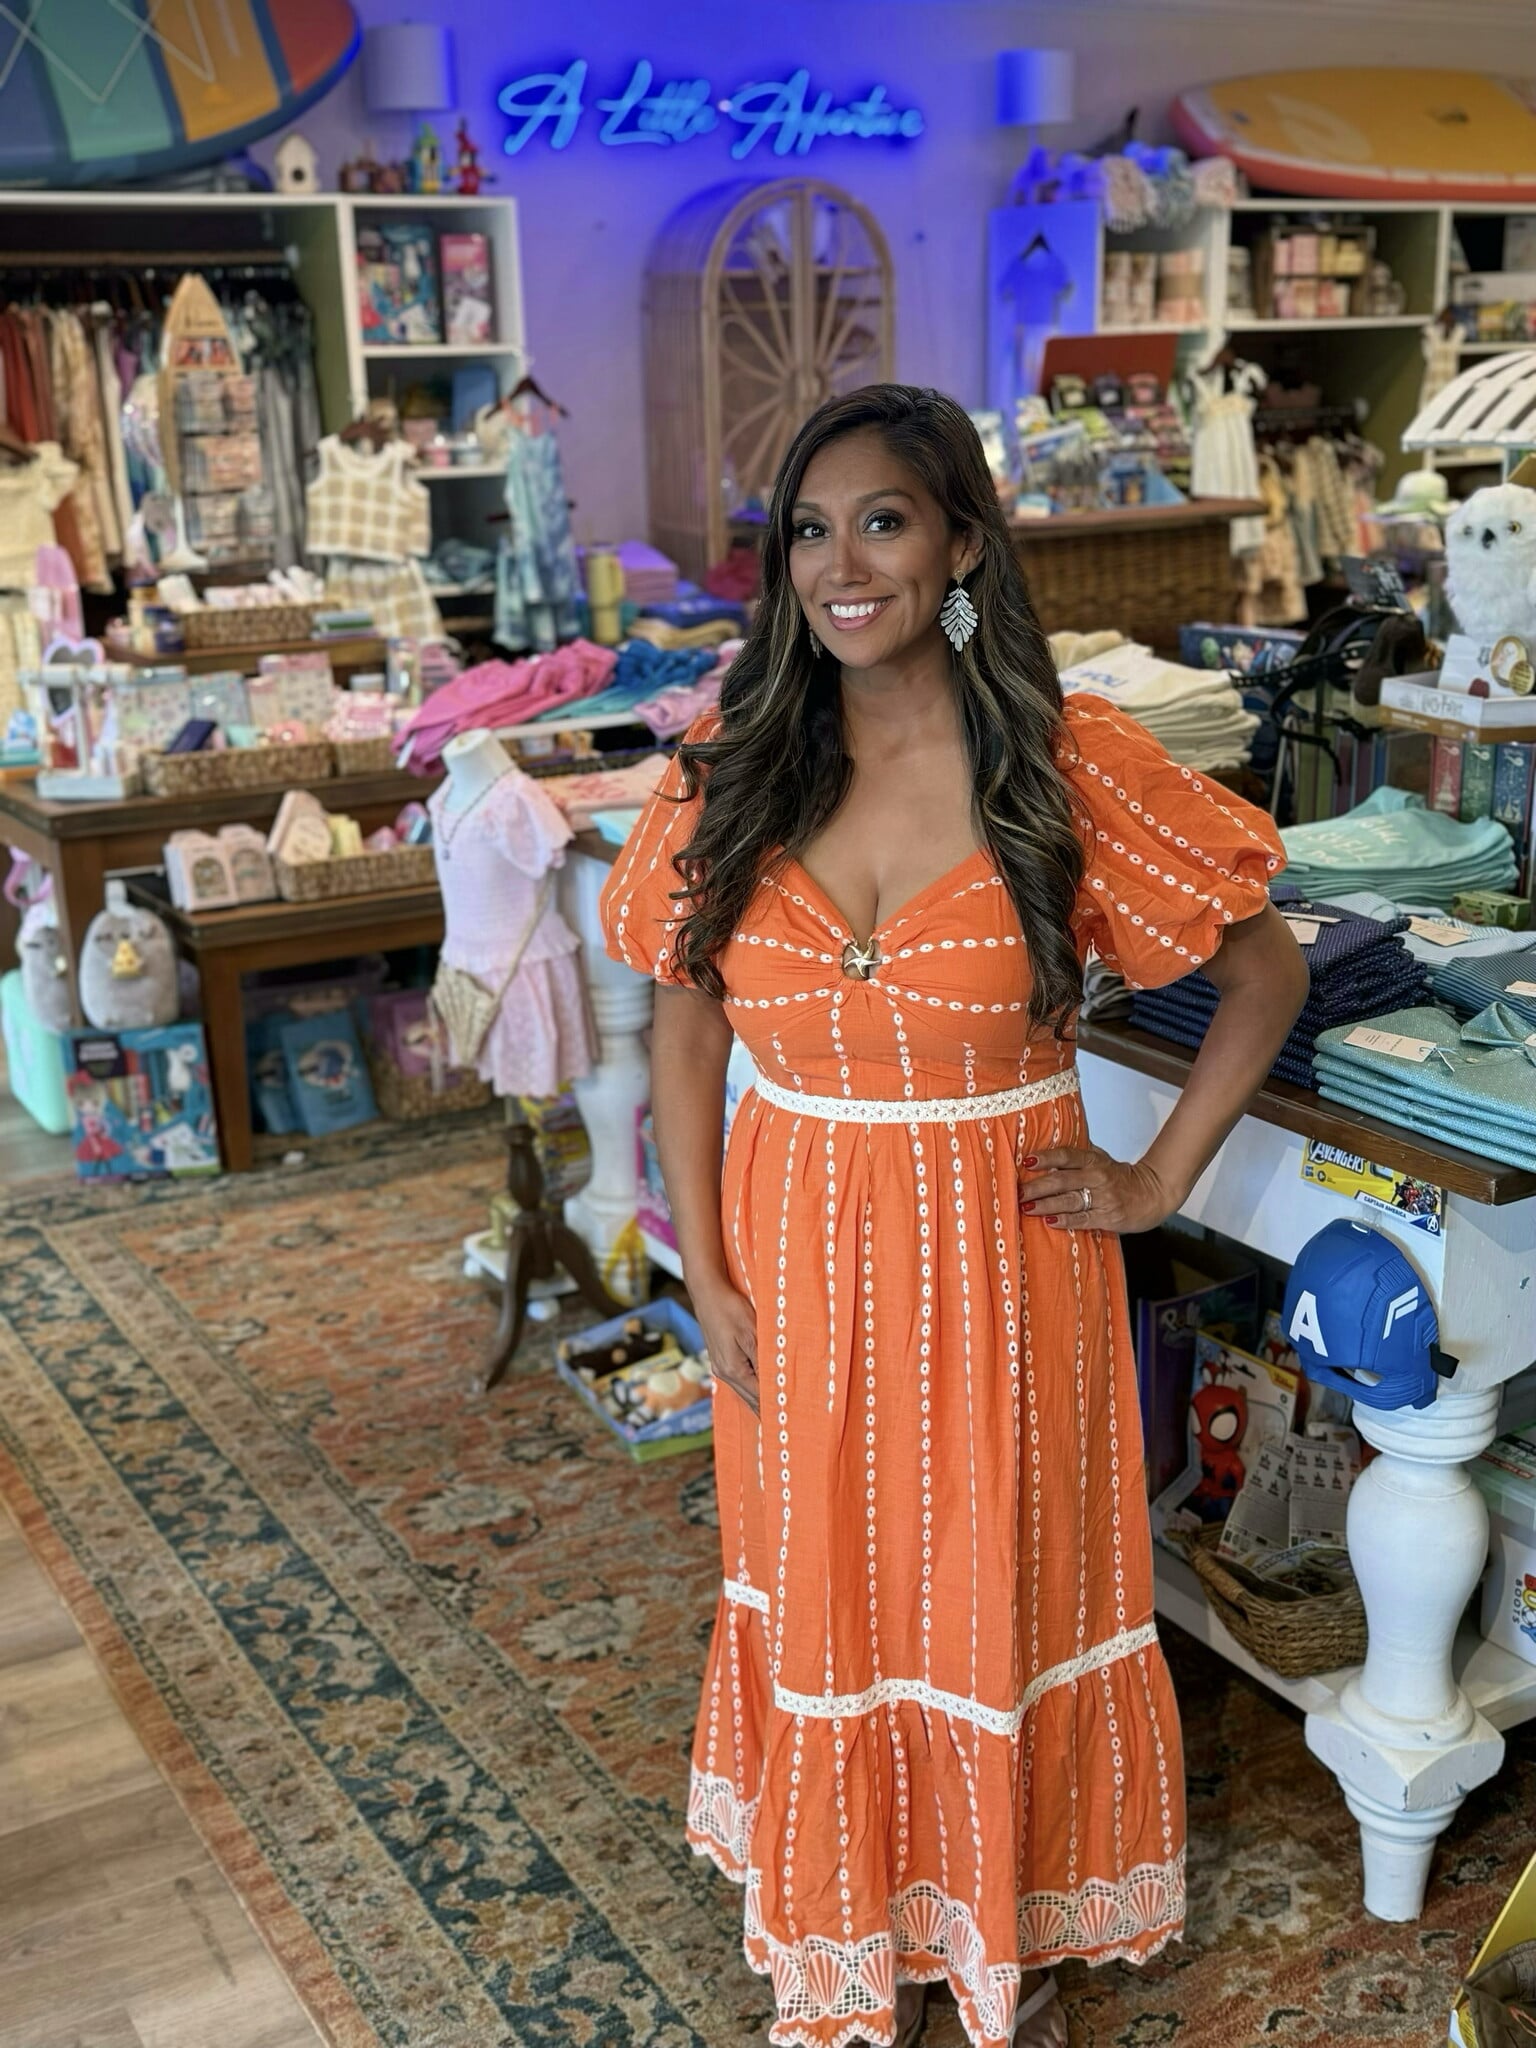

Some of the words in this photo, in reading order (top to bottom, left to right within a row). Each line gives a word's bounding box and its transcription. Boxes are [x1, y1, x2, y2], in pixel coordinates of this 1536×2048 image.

[498, 59, 588, 155] A
[1309, 1140, 1365, 1175] AVENGERS
[1363, 1195, 1385, 1210] CAPTAIN
[1384, 1205, 1407, 1219] AMERICA
[1289, 1290, 1328, 1357] A
[1512, 1578, 1522, 1624] BOOTS
